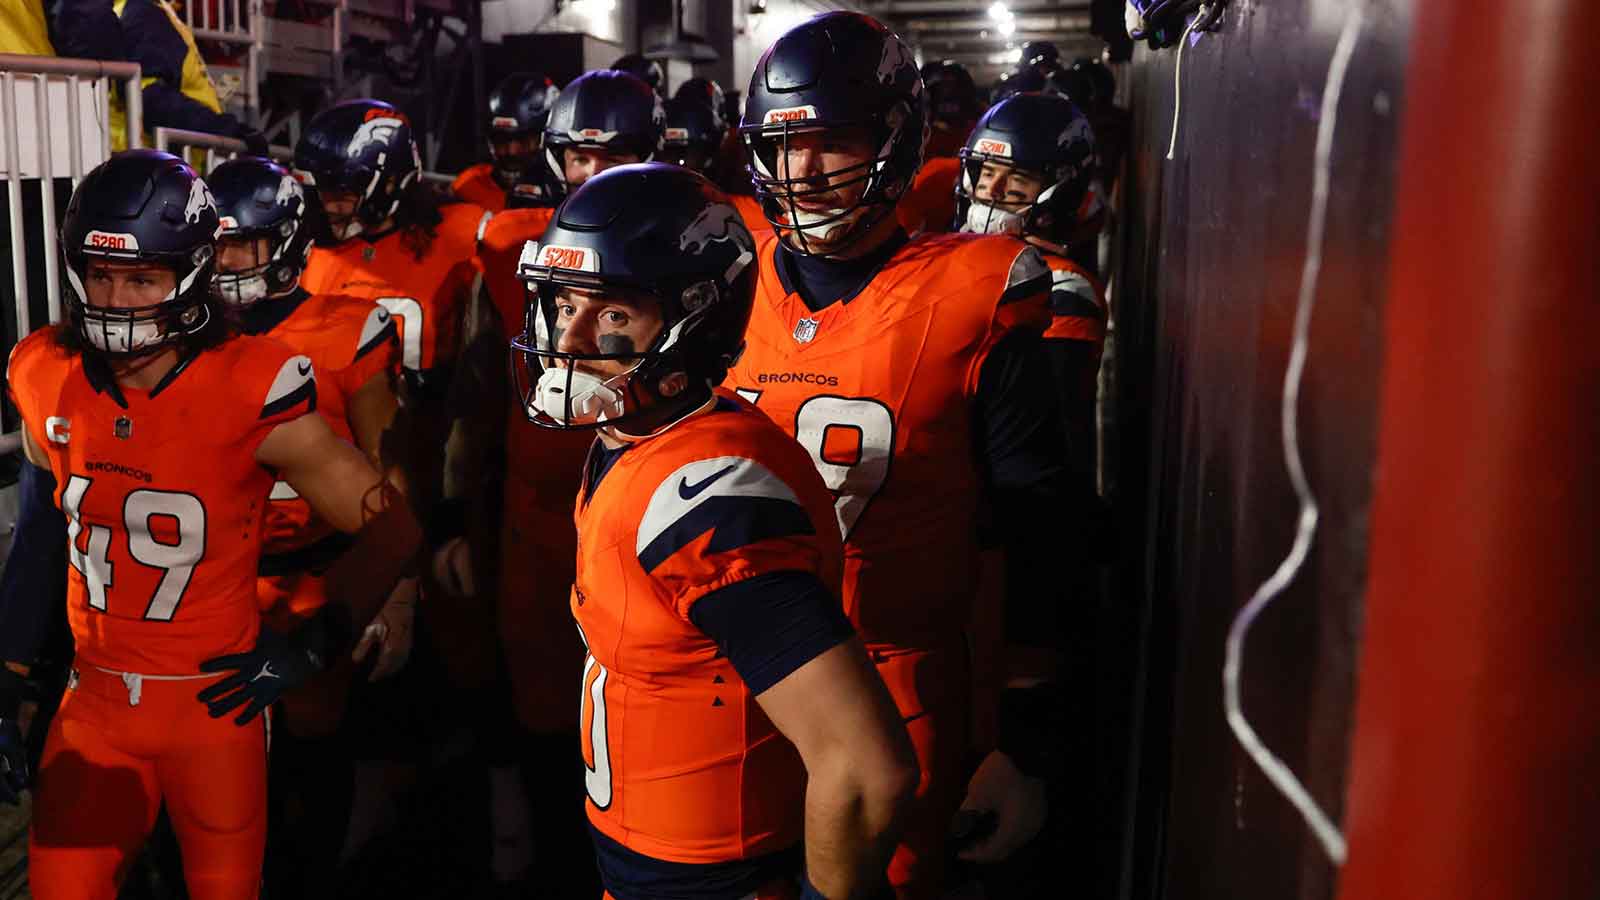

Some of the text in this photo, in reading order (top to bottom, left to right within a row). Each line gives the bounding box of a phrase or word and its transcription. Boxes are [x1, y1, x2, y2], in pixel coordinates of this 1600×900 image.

[91, 234, 126, 249] 5280
[543, 247, 586, 269] 5280
[758, 372, 839, 387] BRONCOS
[45, 416, 71, 444] C
[85, 461, 152, 482] BRONCOS
[736, 387, 897, 543] 9
[61, 474, 207, 622] 49
